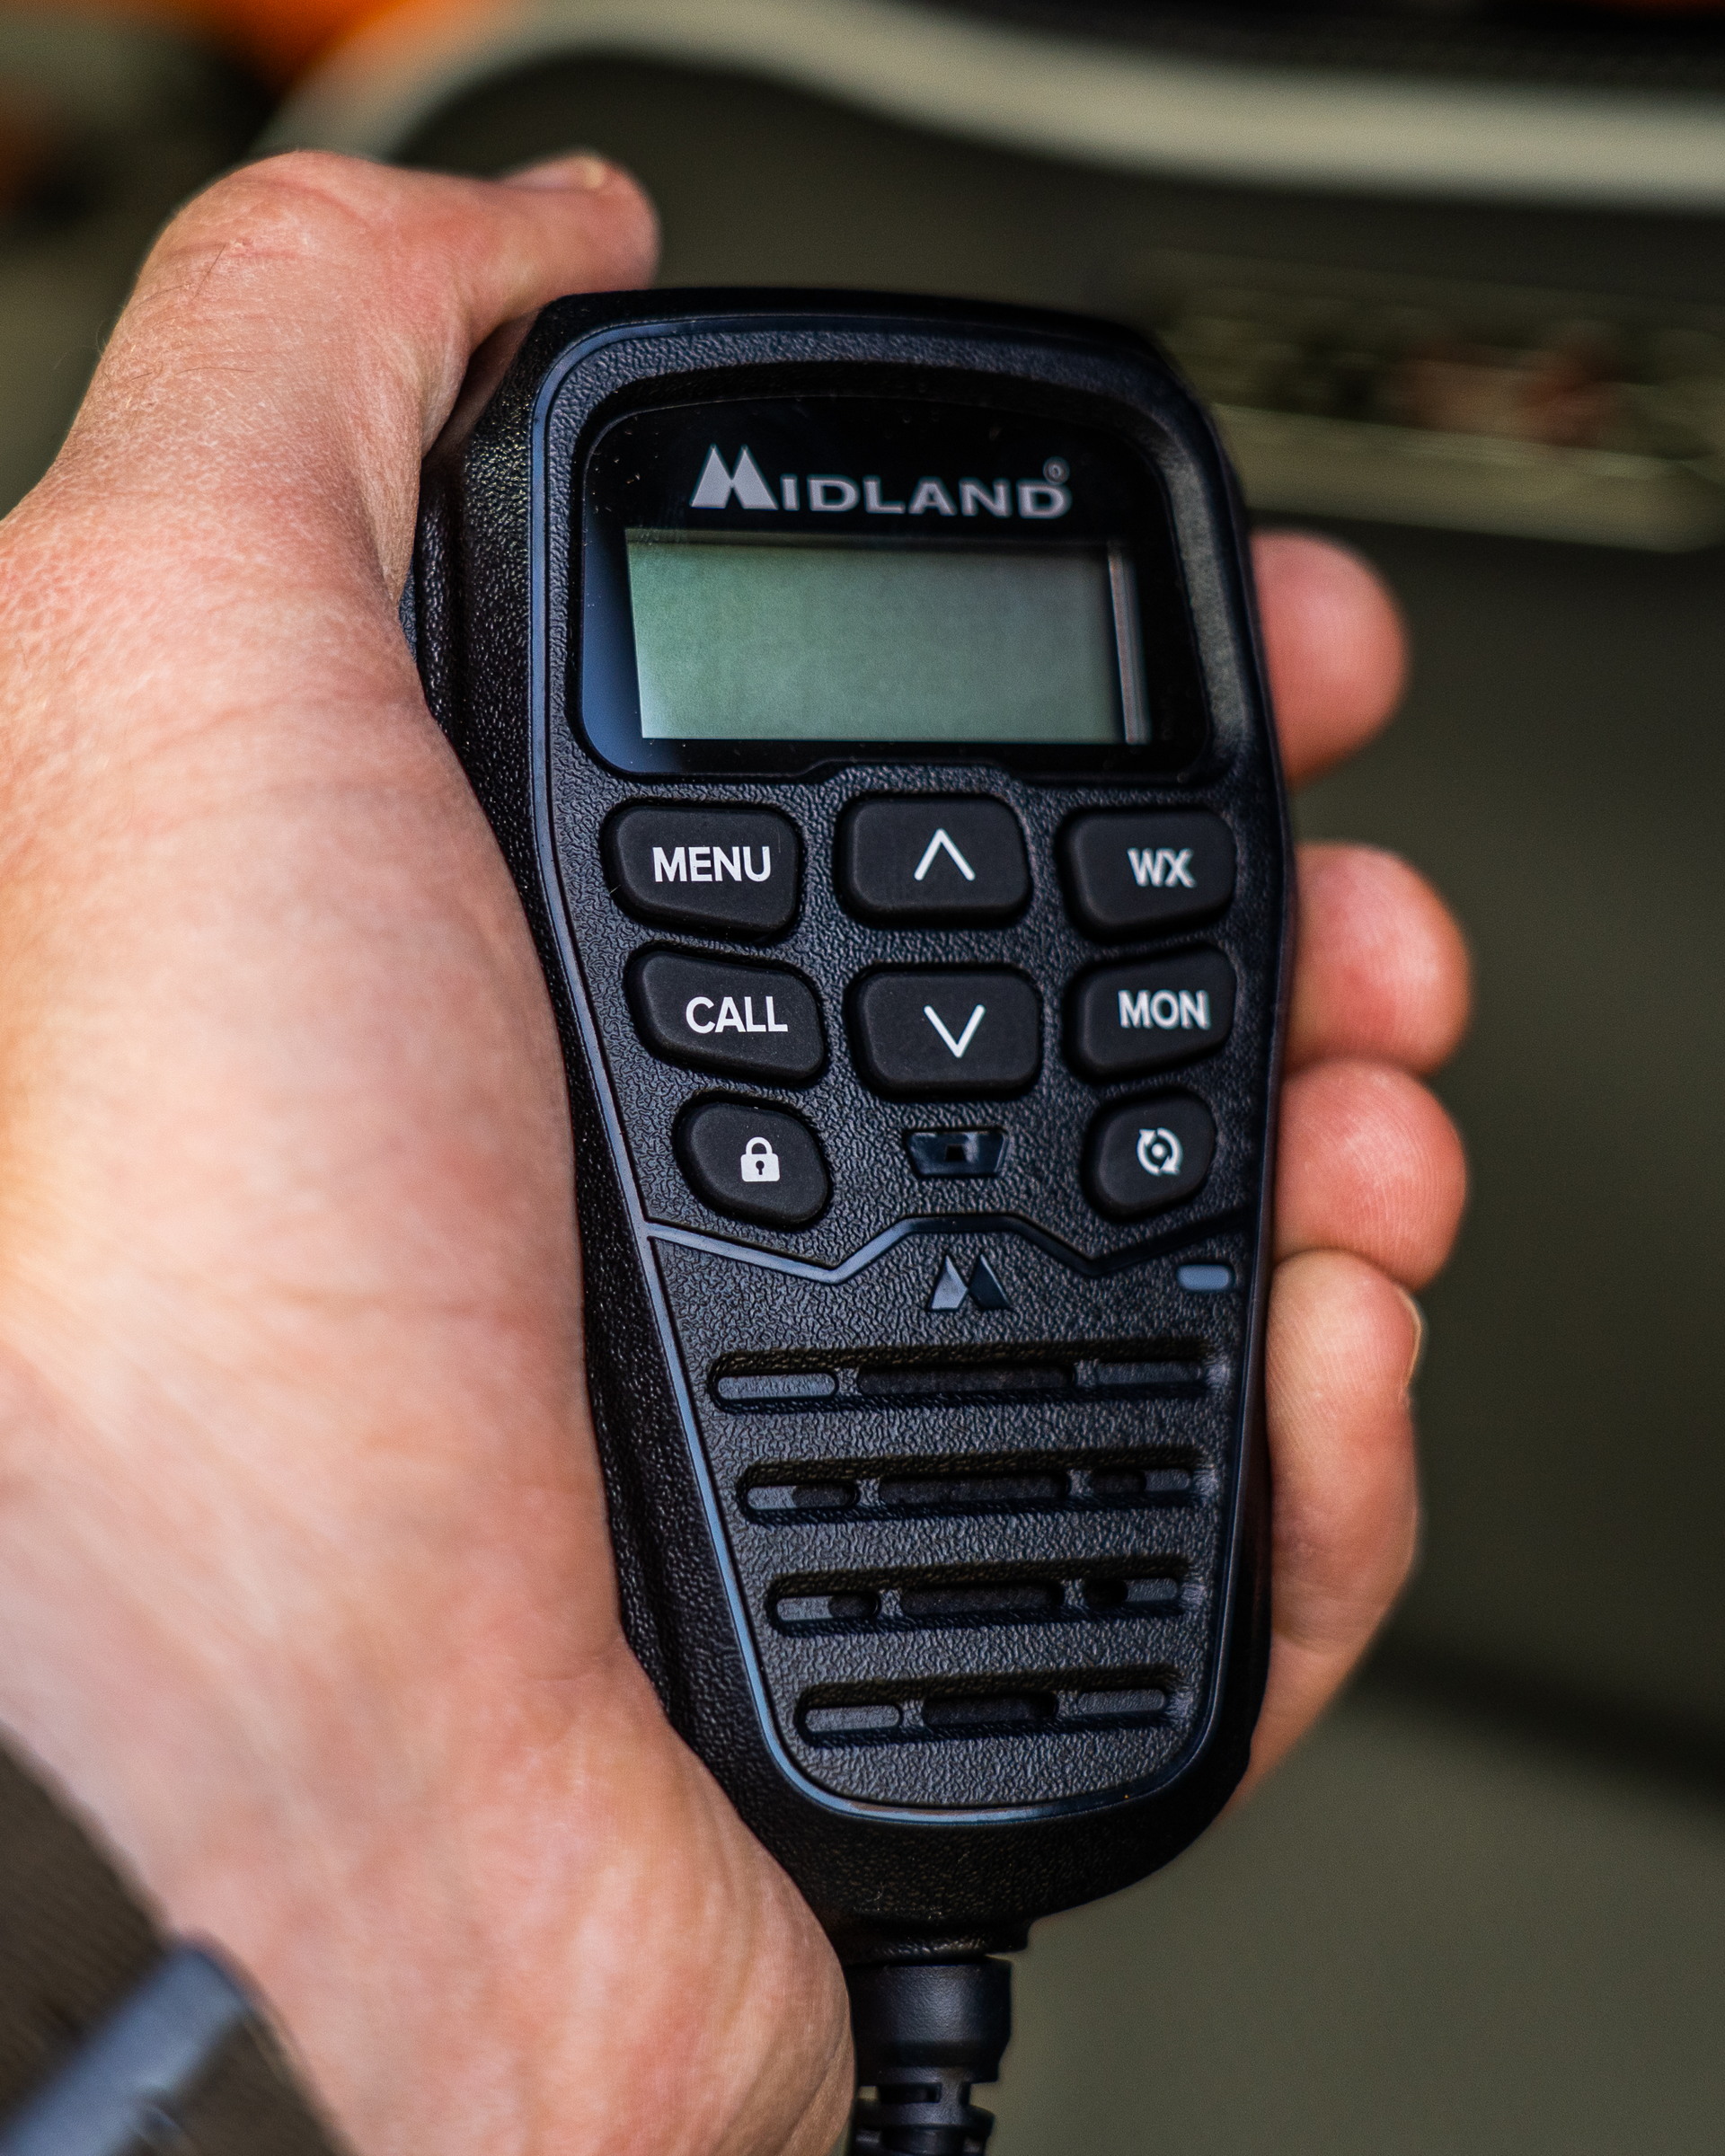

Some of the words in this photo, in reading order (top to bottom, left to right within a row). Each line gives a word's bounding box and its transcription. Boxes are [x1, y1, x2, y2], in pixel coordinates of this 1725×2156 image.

[652, 845, 772, 883] MENU
[1128, 848, 1196, 888] WX
[685, 995, 789, 1034] CALL
[1118, 990, 1210, 1030] MON
